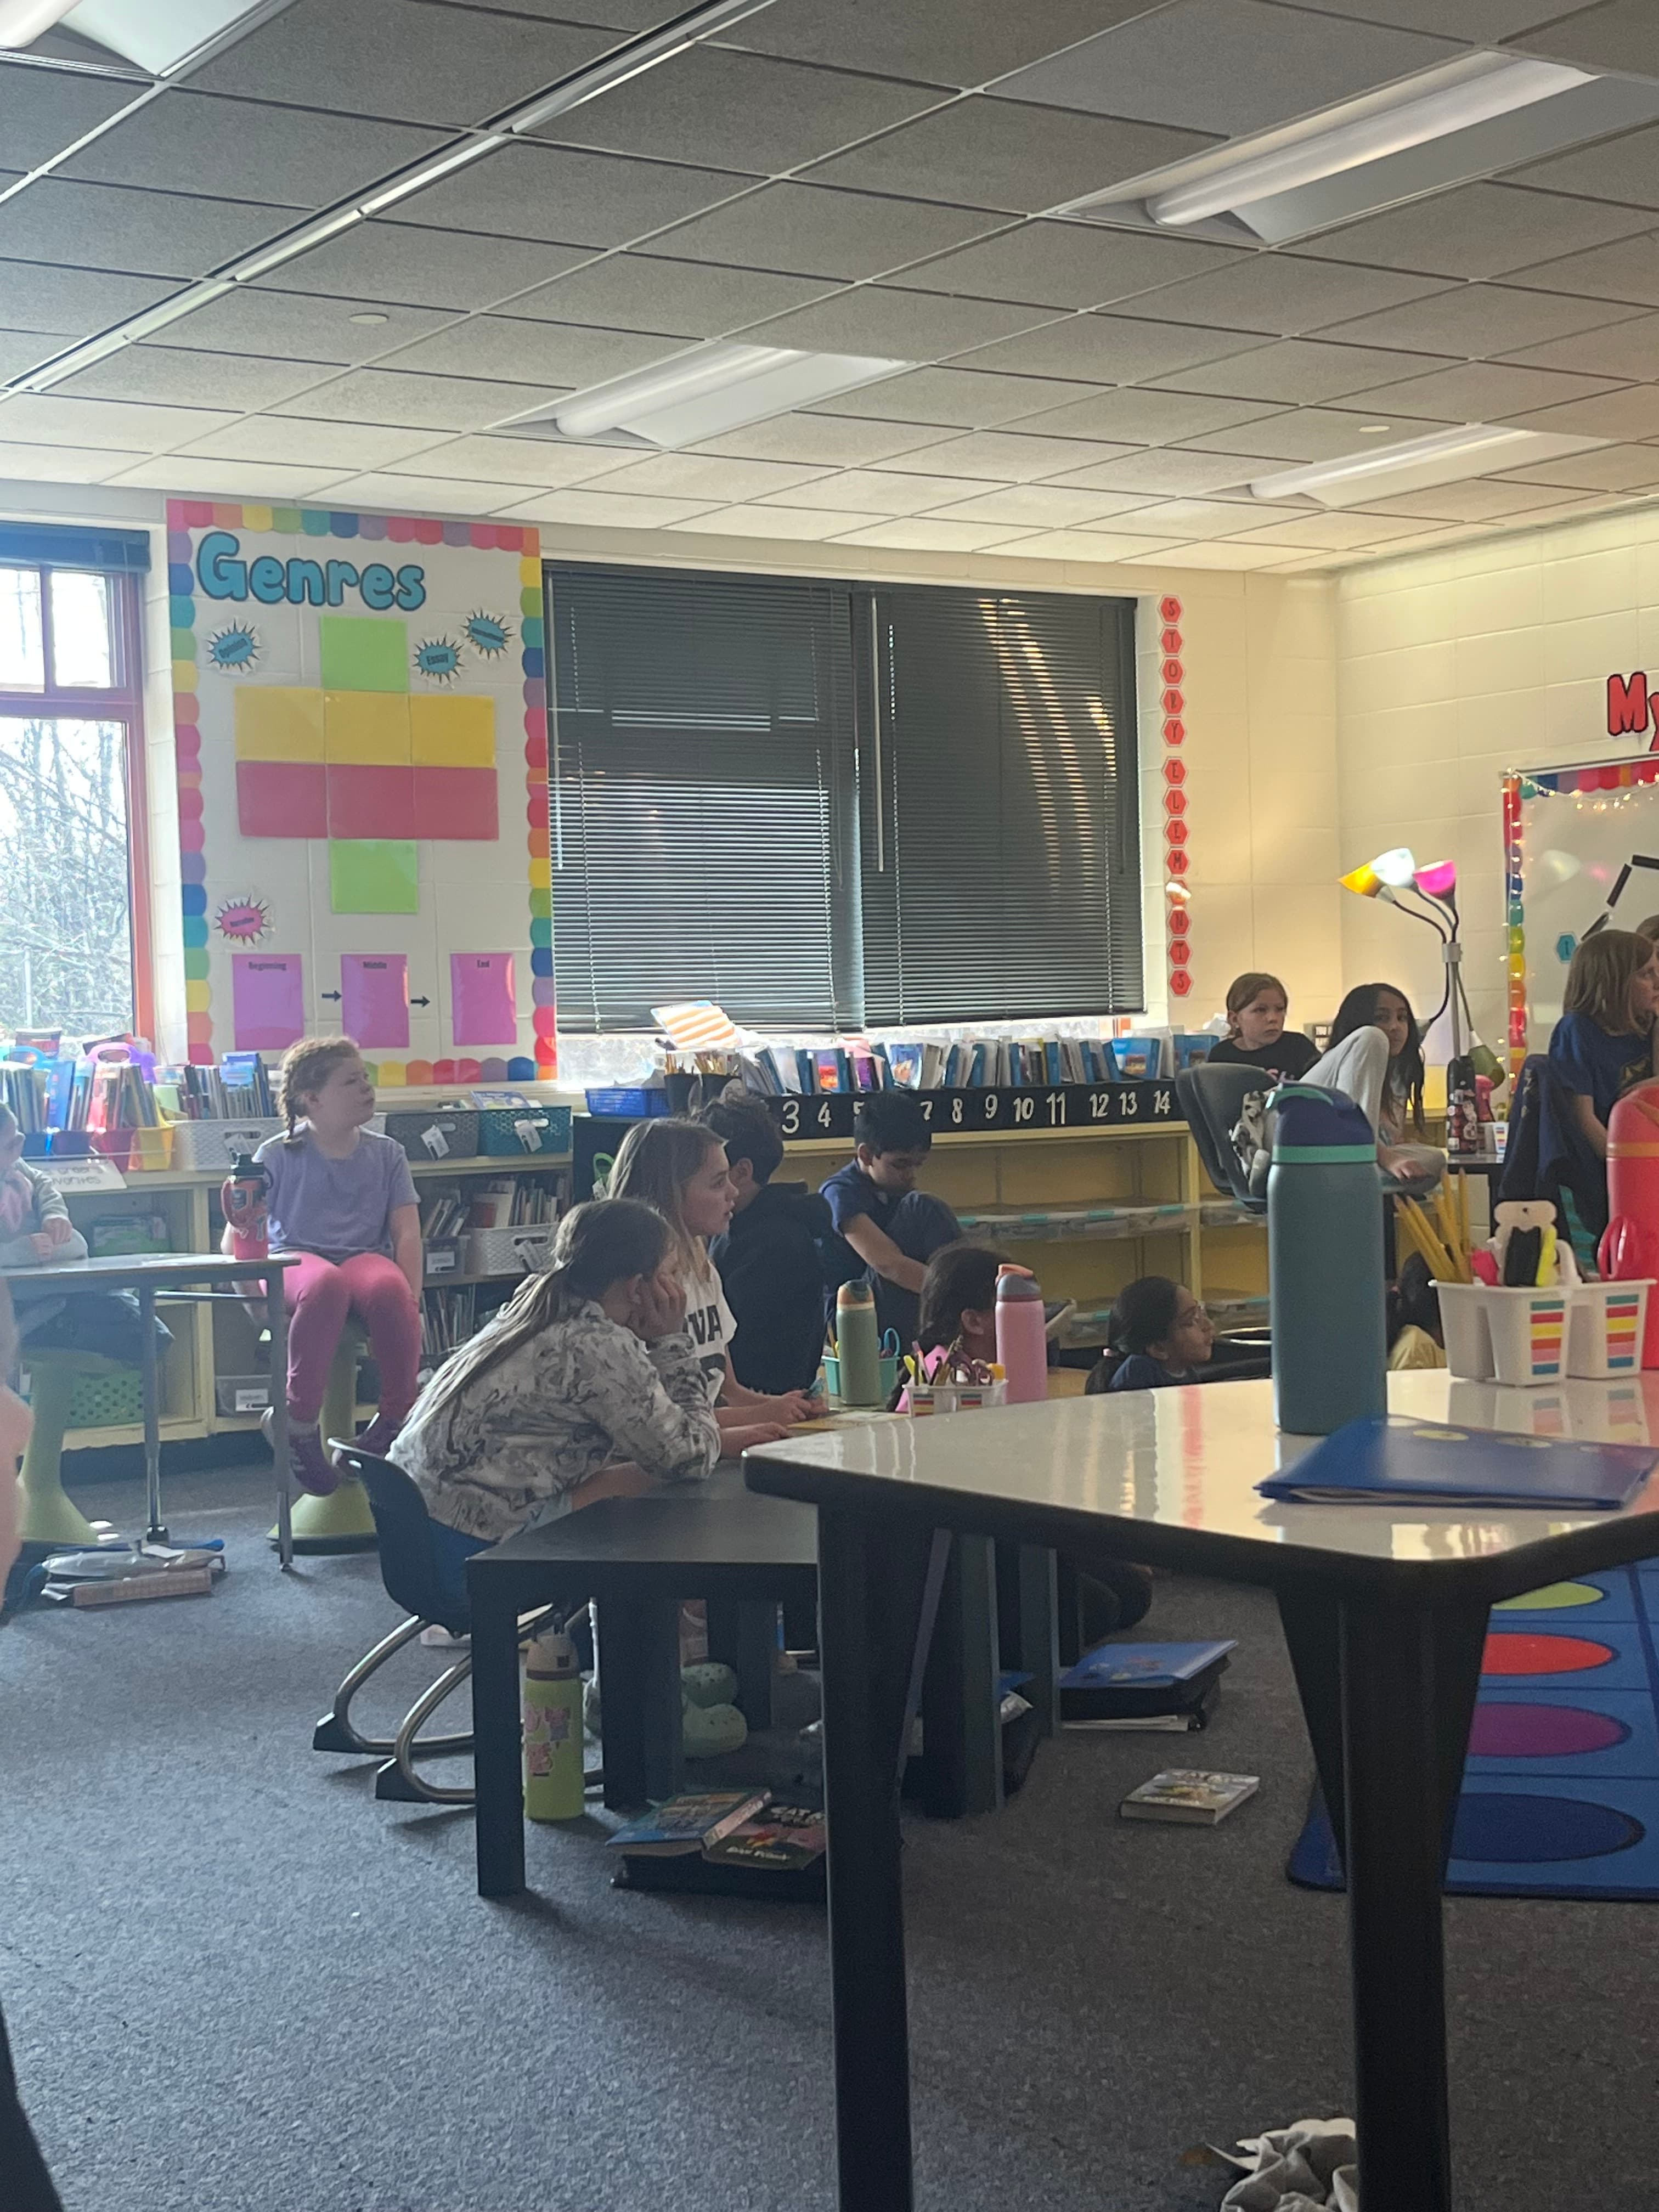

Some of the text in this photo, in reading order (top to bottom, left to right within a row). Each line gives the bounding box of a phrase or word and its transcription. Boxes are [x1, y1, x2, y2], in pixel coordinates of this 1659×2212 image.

[196, 531, 427, 611] Genres
[249, 961, 287, 970] Beginning
[477, 960, 490, 968] End
[781, 1099, 799, 1134] 3
[817, 1102, 832, 1127] 4
[919, 1101, 933, 1121] 7
[951, 1097, 963, 1124] 8
[985, 1093, 998, 1119] 9
[1013, 1097, 1034, 1122] 10
[1046, 1092, 1066, 1124] 11
[1090, 1093, 1109, 1118] 12
[1119, 1091, 1138, 1116] 13
[1154, 1090, 1171, 1115] 14
[682, 1305, 724, 1345] VA
